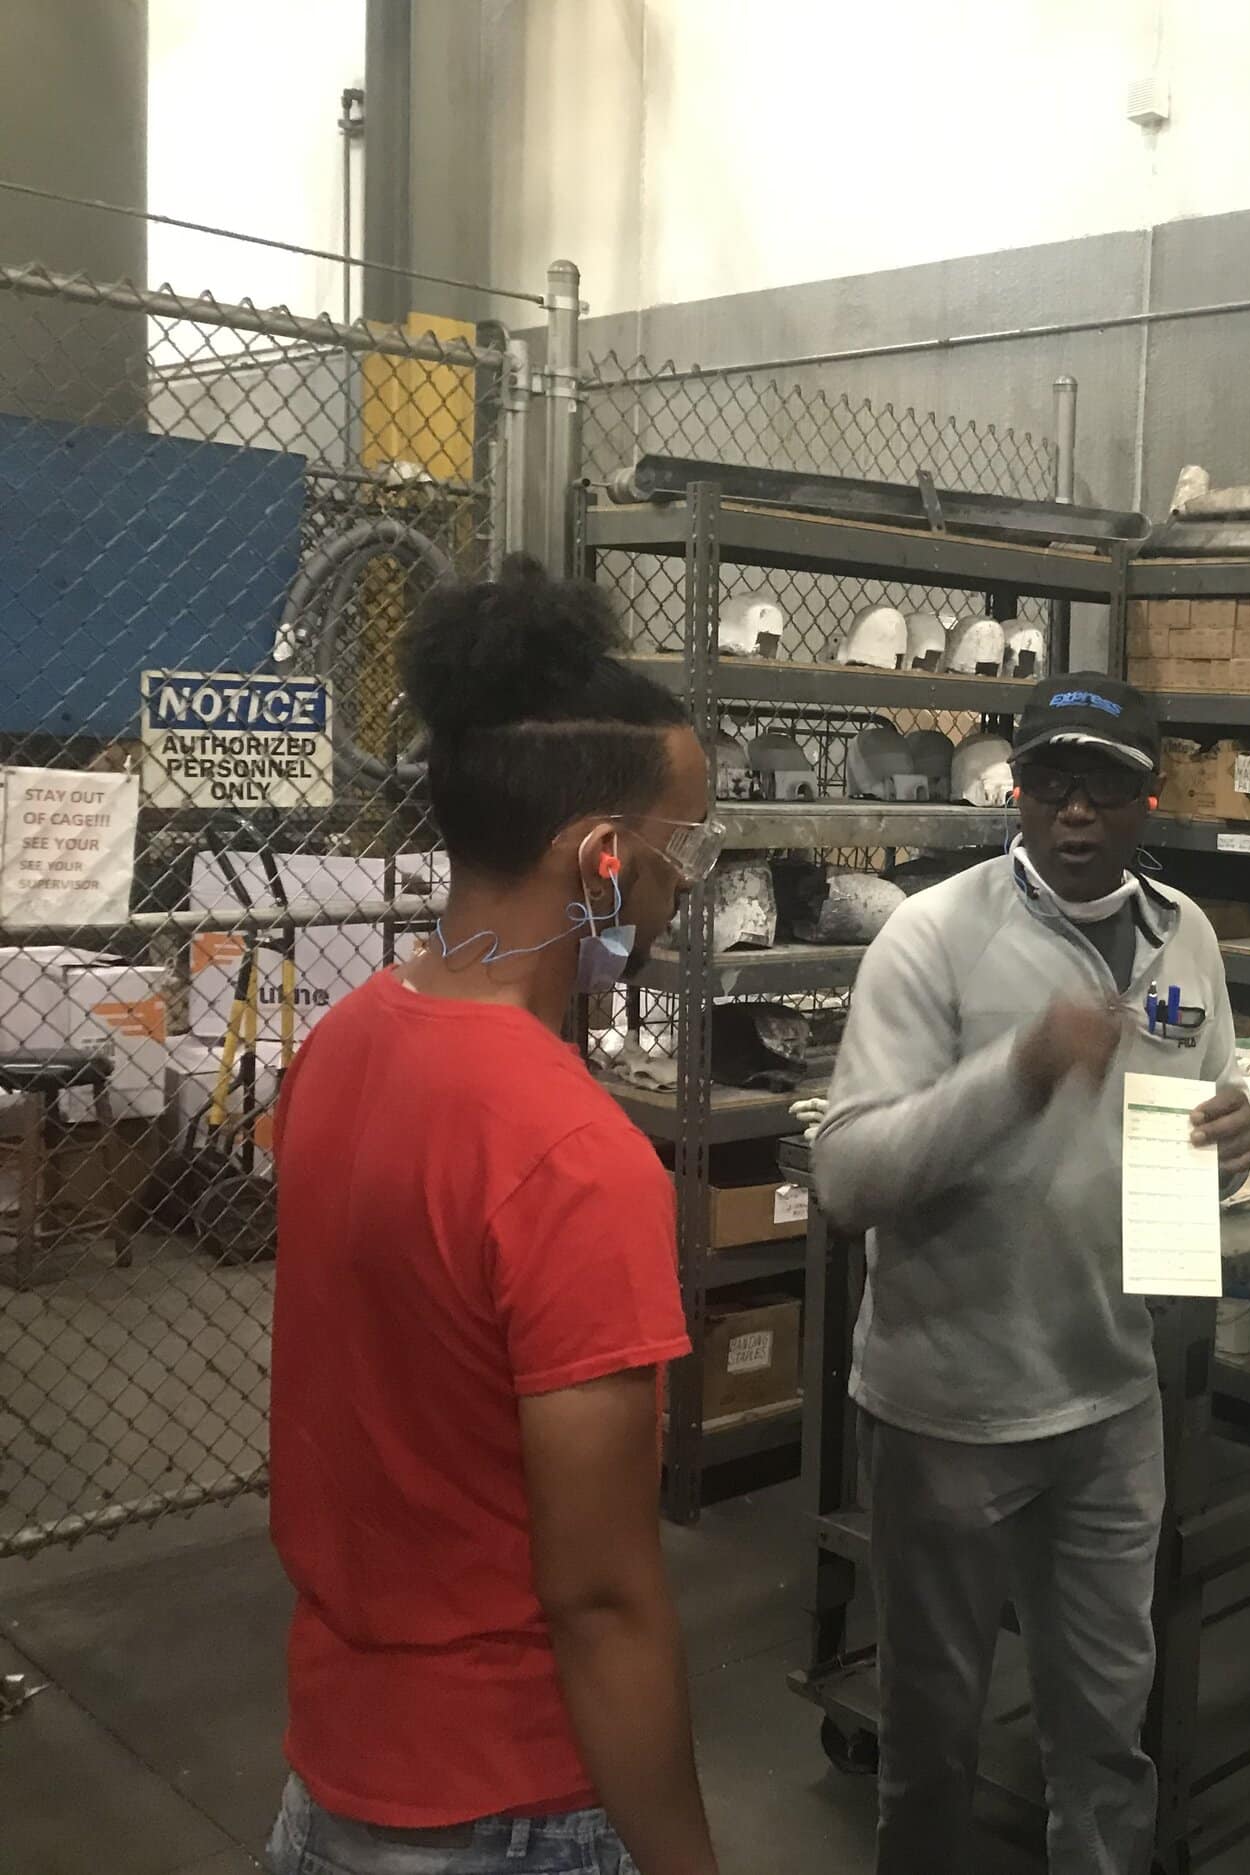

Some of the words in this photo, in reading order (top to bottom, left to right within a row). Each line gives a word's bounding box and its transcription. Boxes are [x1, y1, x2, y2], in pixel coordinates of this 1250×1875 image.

[158, 686, 319, 725] NOTICE
[162, 735, 317, 756] AUTHORIZED
[166, 758, 312, 778] PERSONNEL
[25, 788, 66, 802] STAY
[70, 791, 105, 804] OUT
[211, 781, 271, 801] ONLY
[23, 812, 46, 825] OF
[50, 813, 111, 828] CAGE!!!
[22, 837, 49, 850] SEE
[53, 838, 99, 851] YOUR
[20, 860, 43, 871] SEE
[47, 861, 83, 872] YOUR
[18, 879, 100, 890] SUPERVISOR
[1178, 1037, 1197, 1049] FILA
